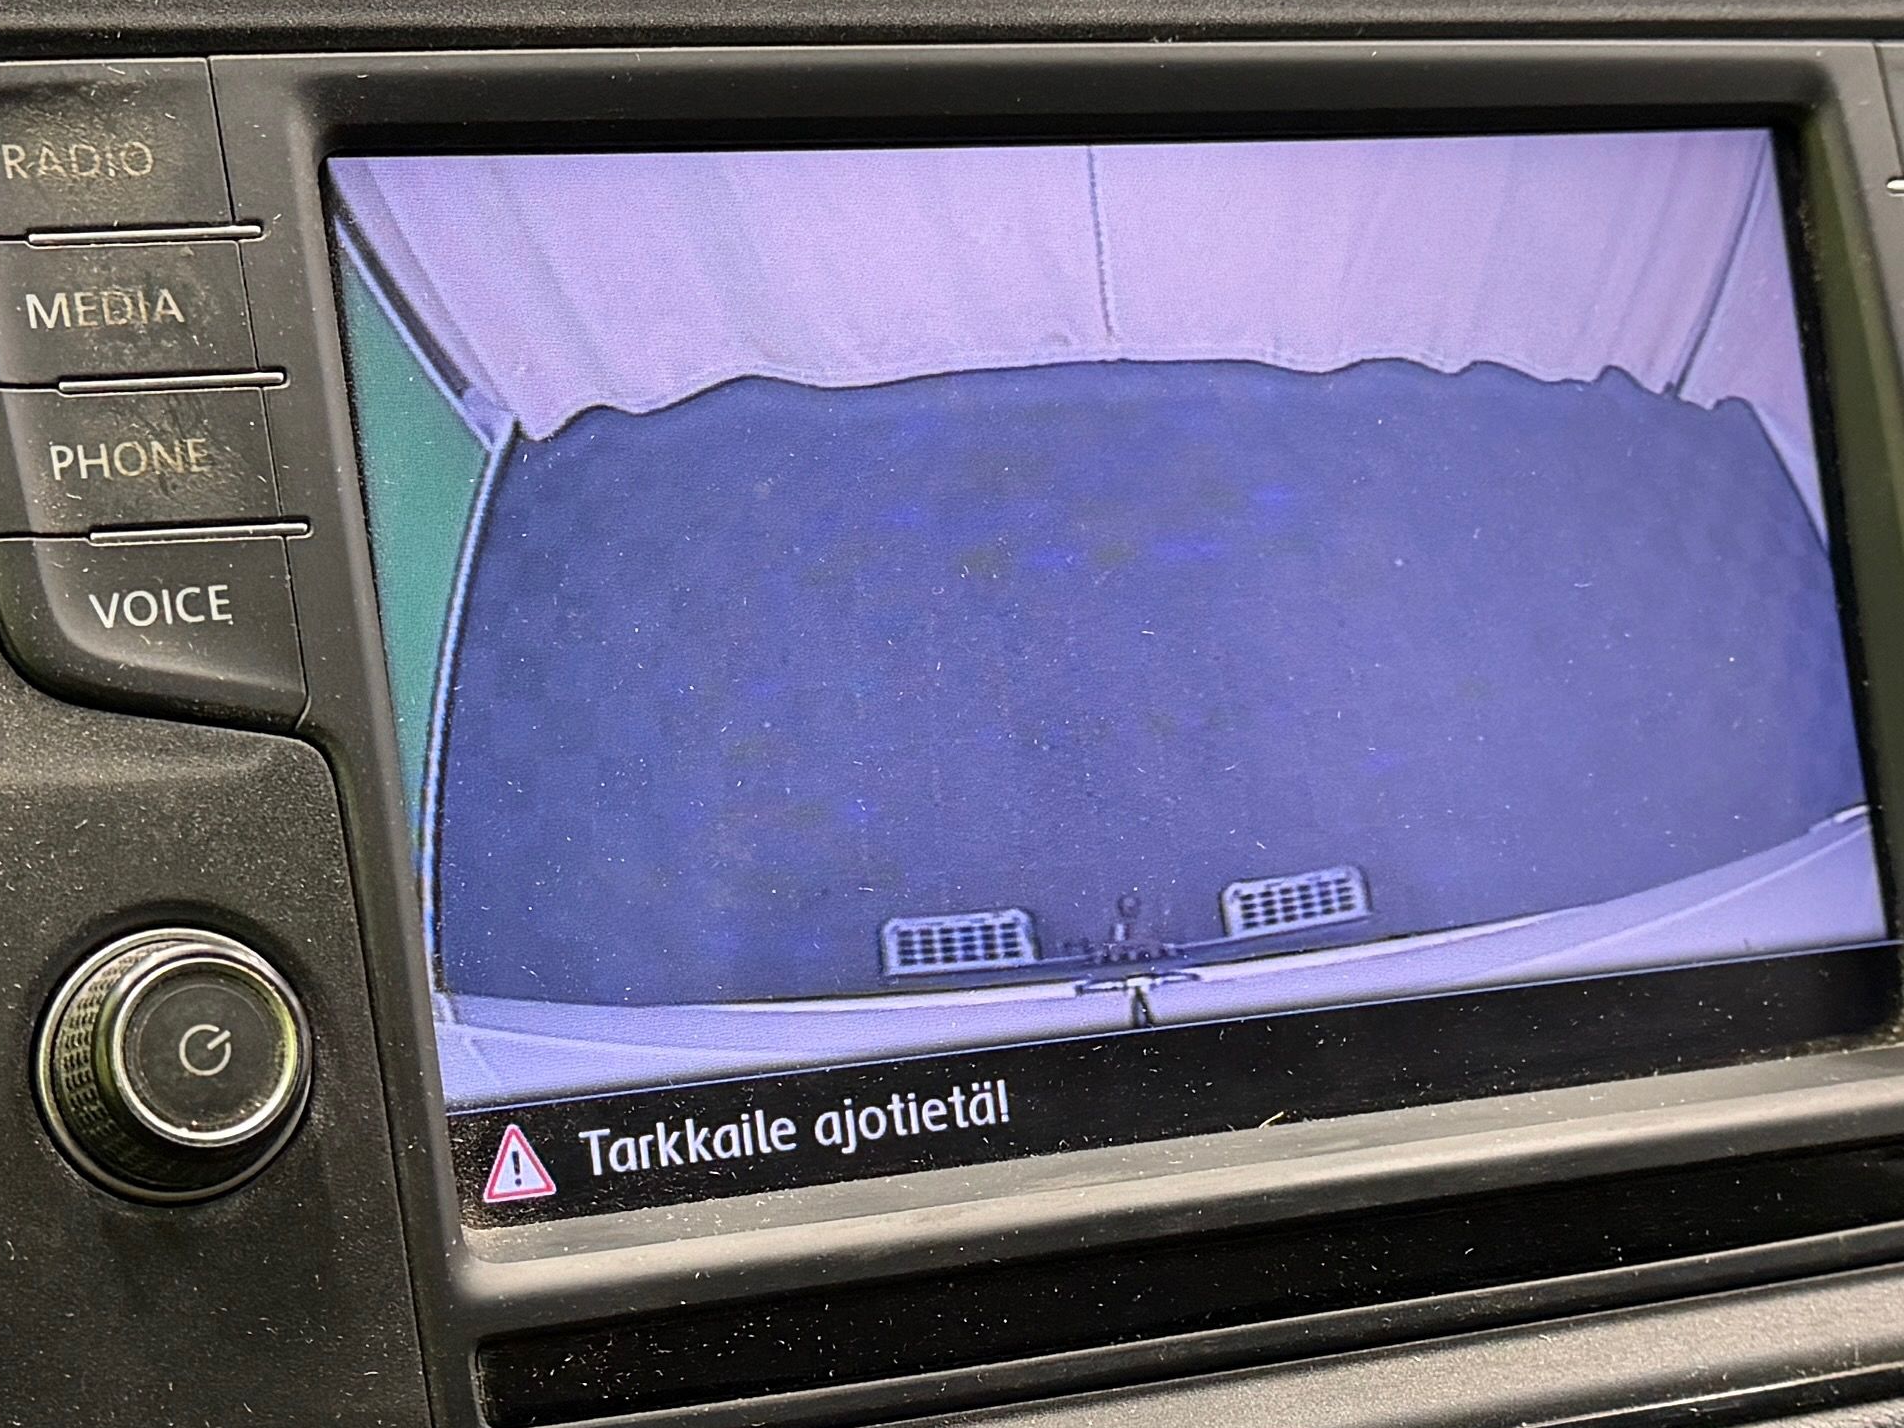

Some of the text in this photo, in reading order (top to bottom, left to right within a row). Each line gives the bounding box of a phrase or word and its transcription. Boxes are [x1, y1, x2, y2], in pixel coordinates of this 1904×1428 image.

[1, 141, 153, 180] RADIO
[24, 291, 186, 330] MEDIA
[50, 438, 208, 481] PHONE
[88, 584, 233, 630] VOICE
[579, 1079, 1010, 1176] Tarkkaile ajotietä!
